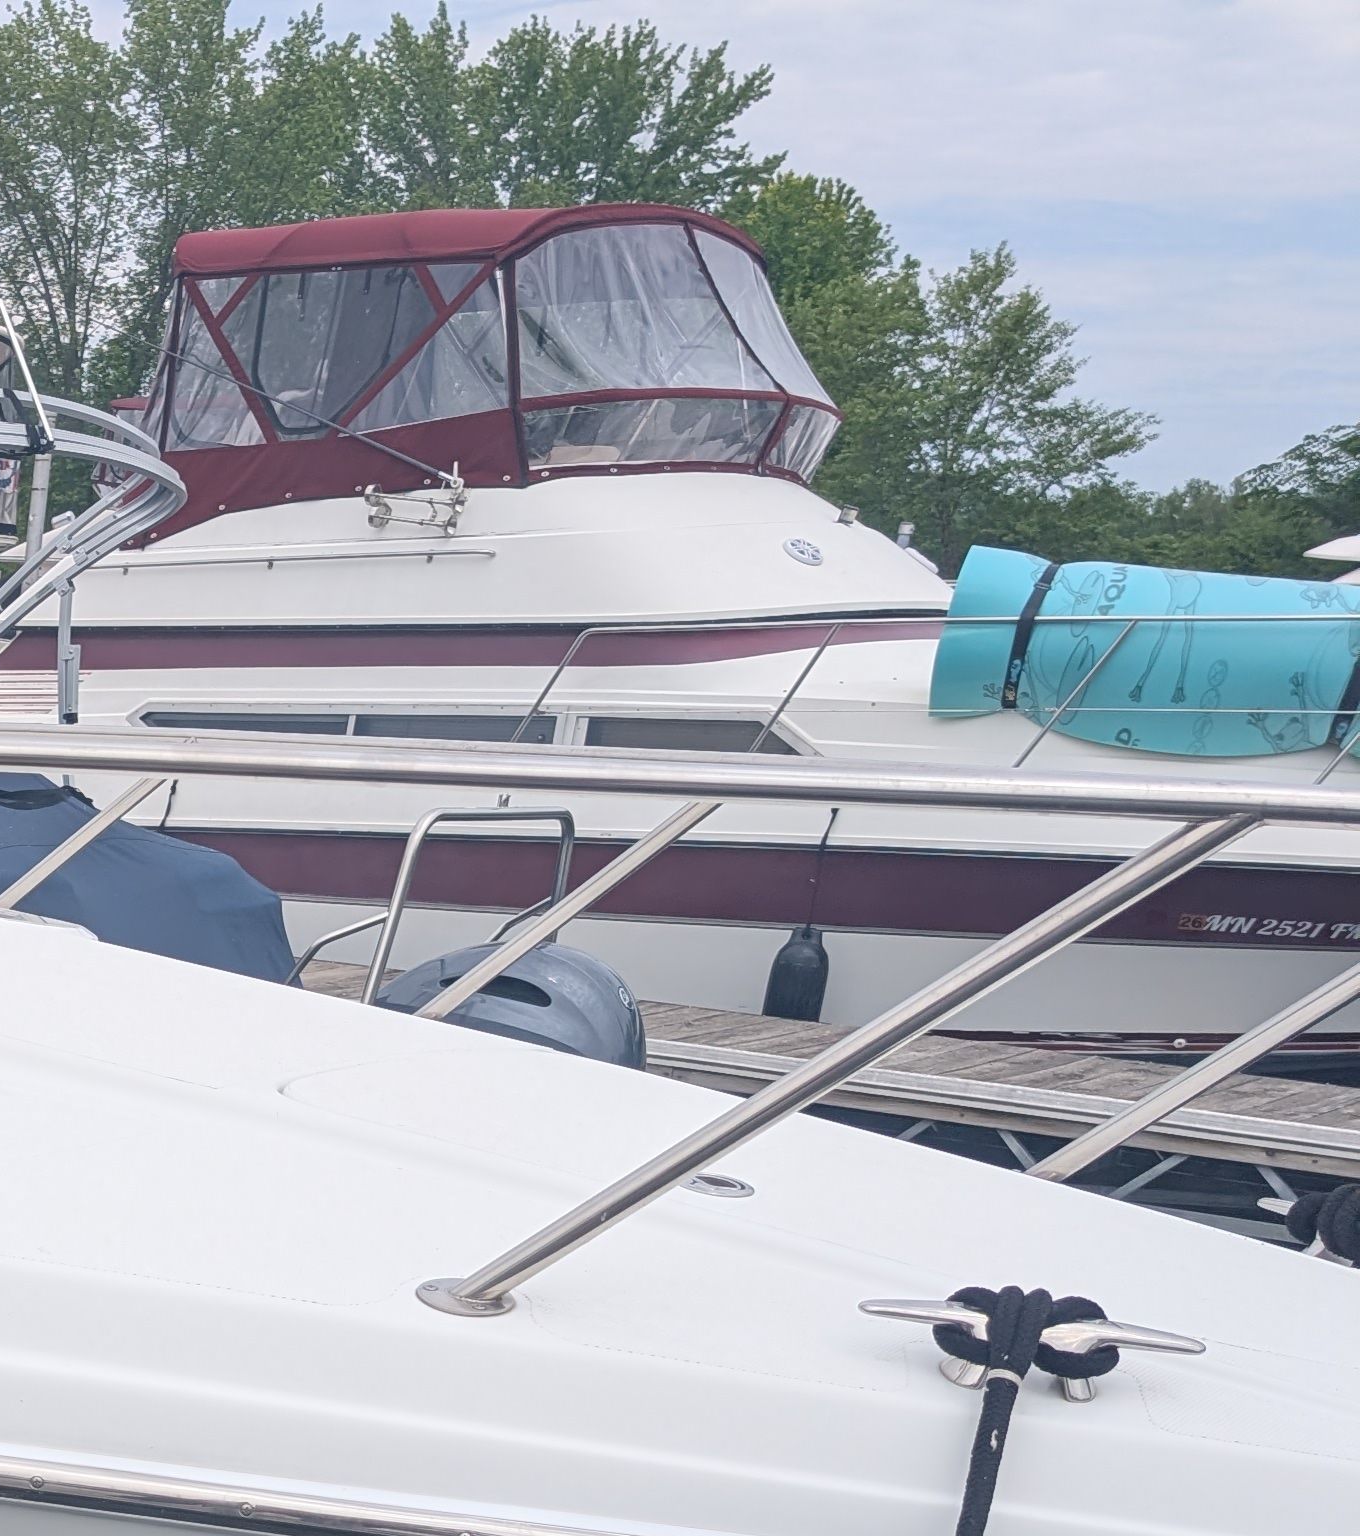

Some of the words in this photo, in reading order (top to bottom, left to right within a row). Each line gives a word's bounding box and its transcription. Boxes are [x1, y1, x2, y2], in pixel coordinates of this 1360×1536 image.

[1180, 916, 1203, 928] 26
[1203, 915, 1256, 934] MN
[1256, 919, 1325, 938] 2521
